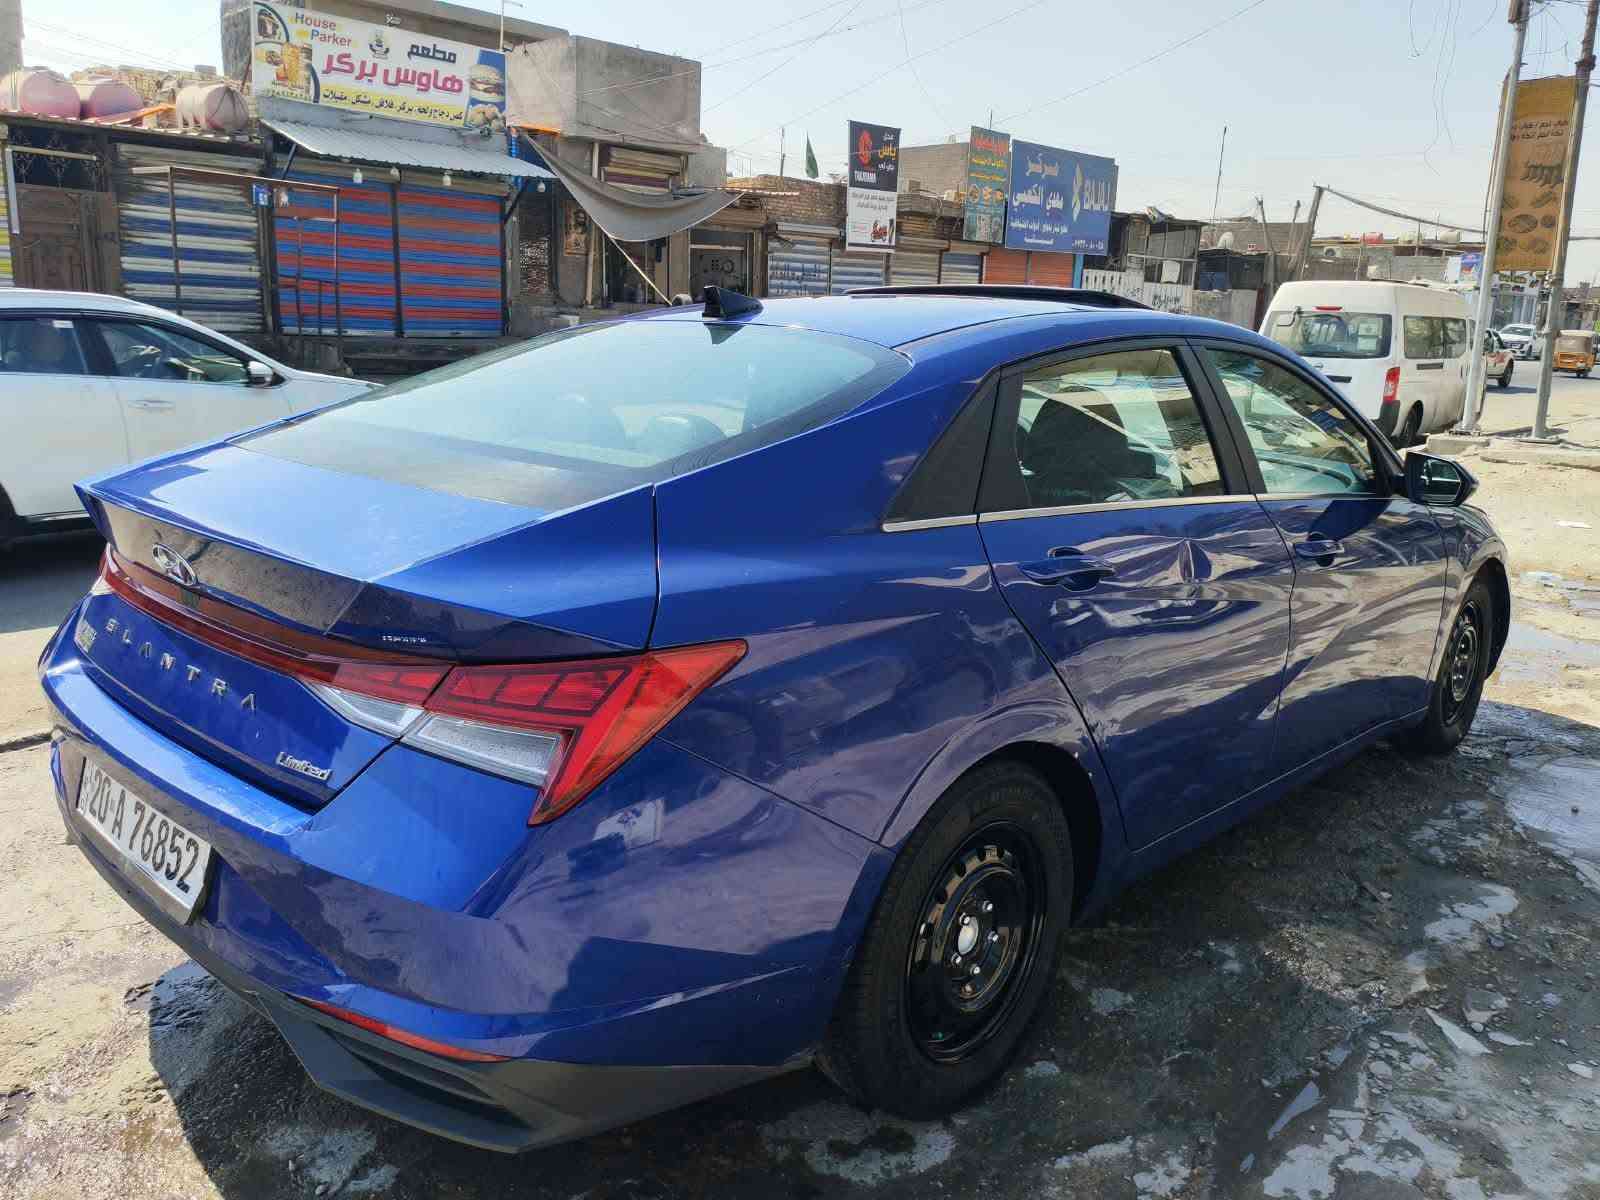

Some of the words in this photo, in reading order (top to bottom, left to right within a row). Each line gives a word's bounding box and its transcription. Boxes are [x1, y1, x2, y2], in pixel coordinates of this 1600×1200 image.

[294, 12, 337, 31] House
[310, 29, 353, 49] Parker
[321, 52, 378, 83] بركر
[407, 43, 457, 64] مطعم
[382, 66, 464, 94] هاوس
[322, 88, 347, 101] مقبلات
[103, 617, 257, 713] ELANTRA
[276, 751, 334, 781] Limited
[130, 802, 200, 893] 76852
